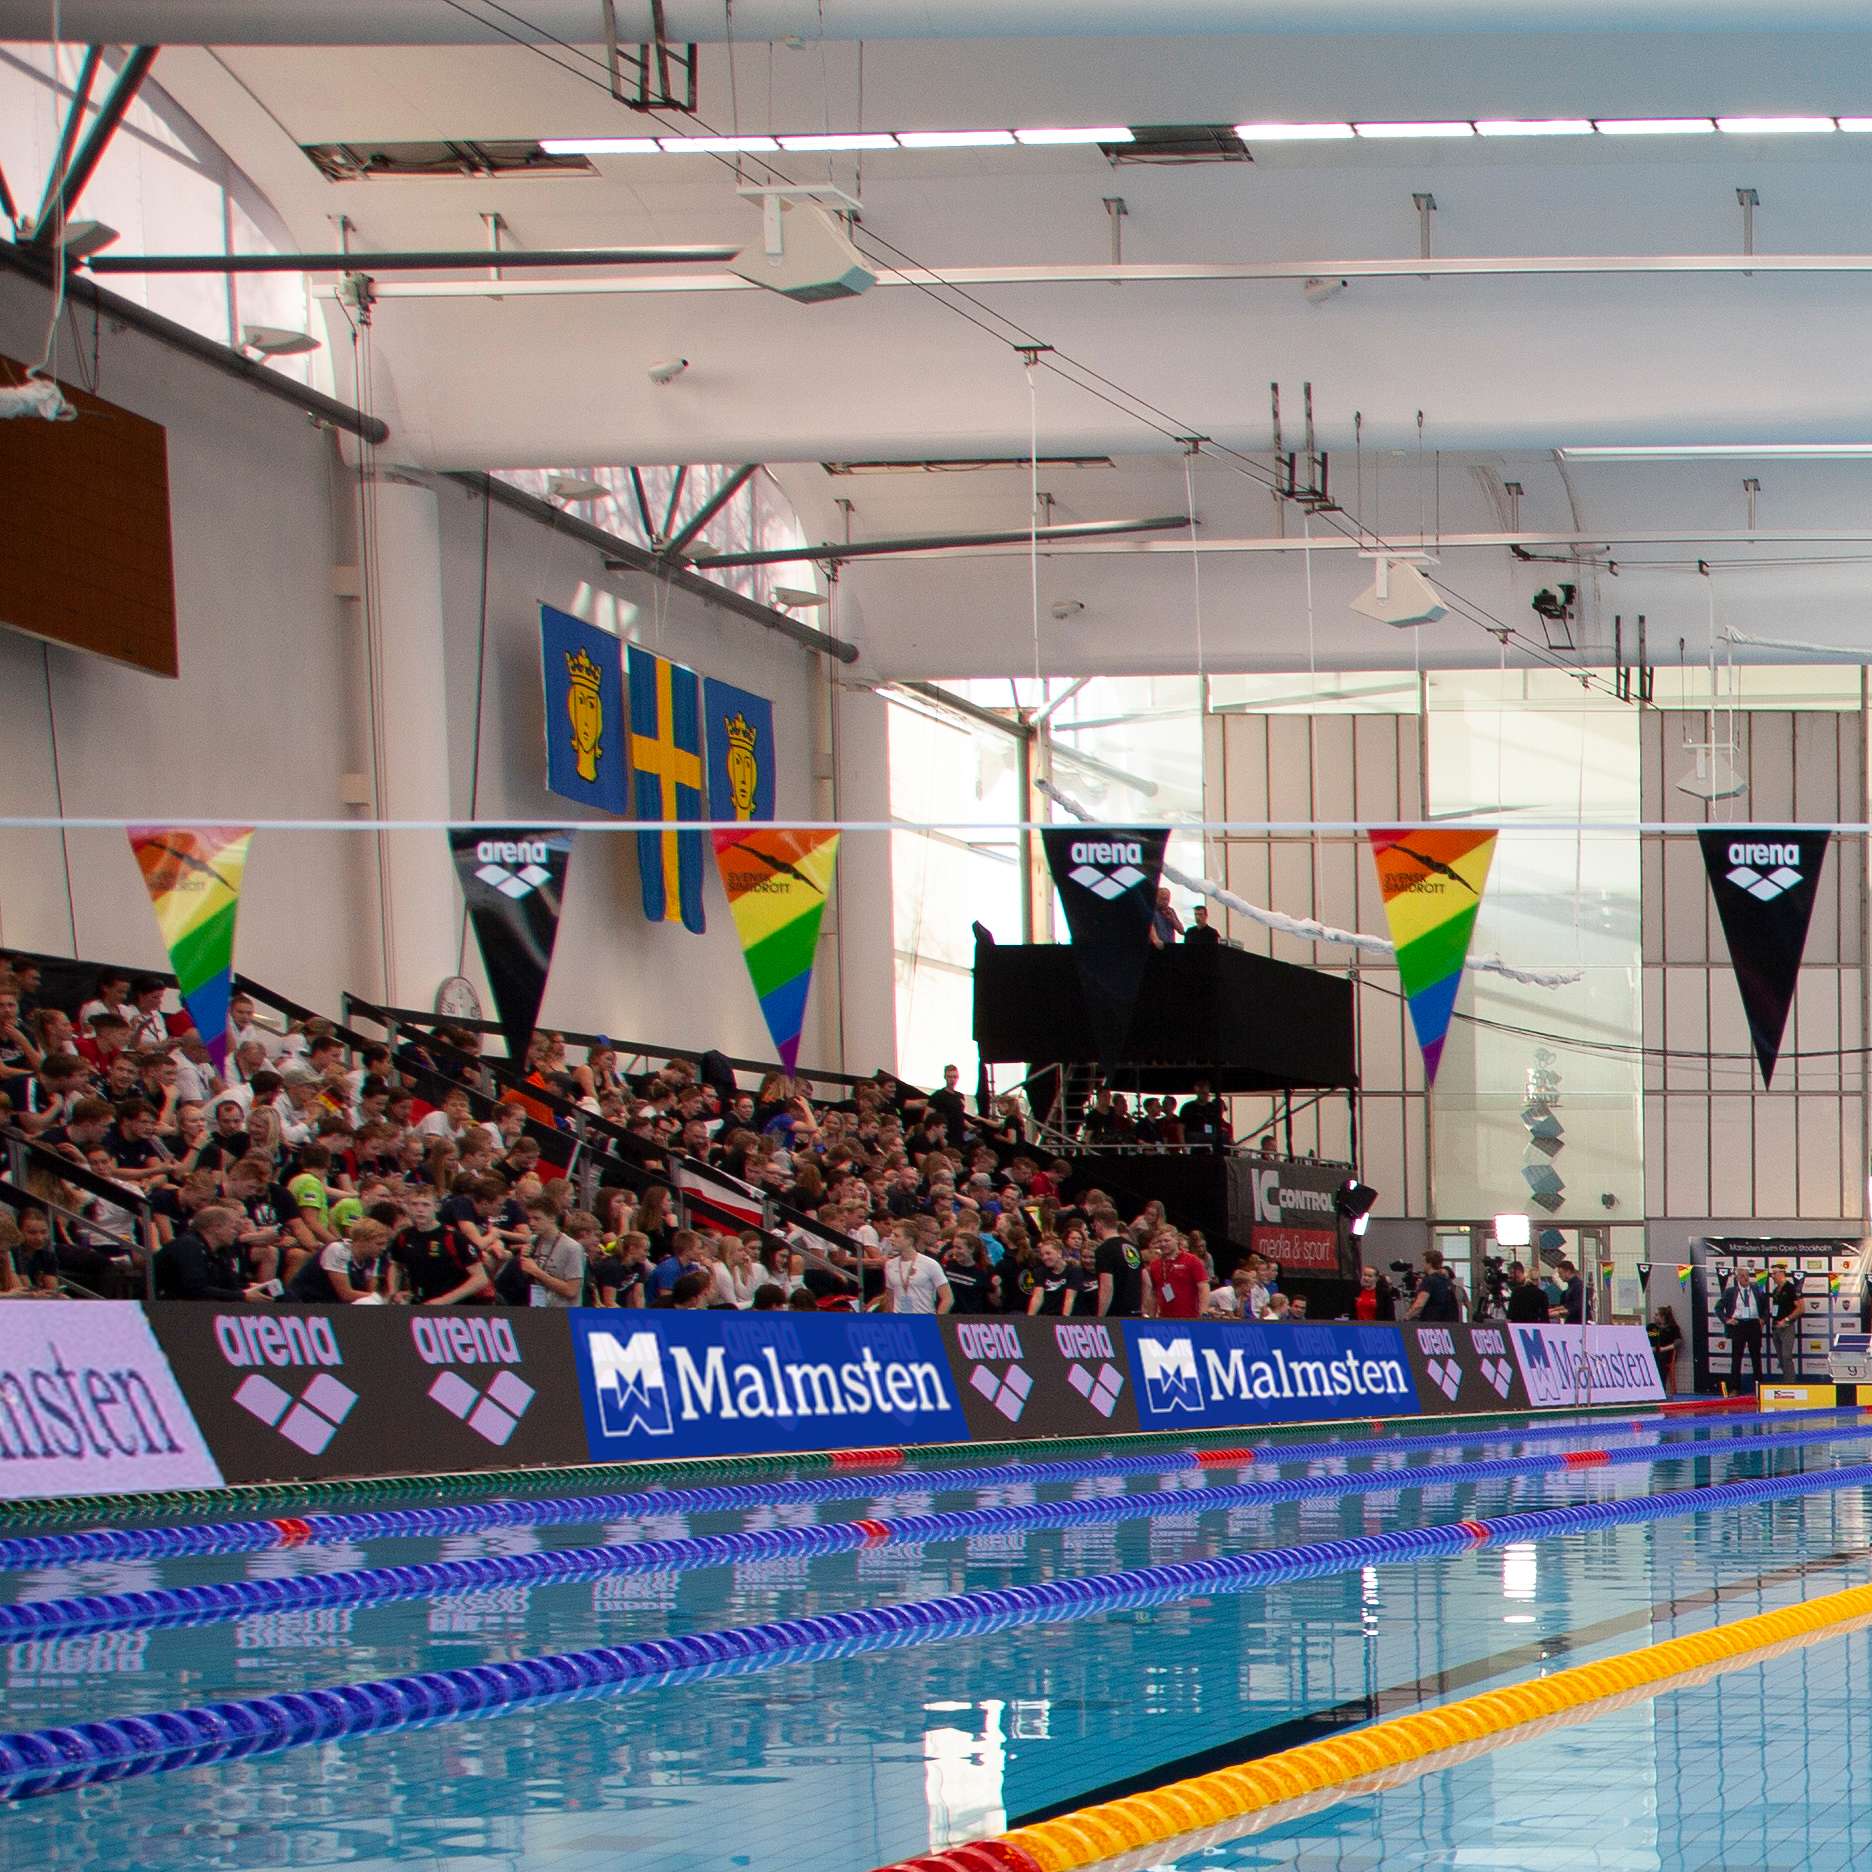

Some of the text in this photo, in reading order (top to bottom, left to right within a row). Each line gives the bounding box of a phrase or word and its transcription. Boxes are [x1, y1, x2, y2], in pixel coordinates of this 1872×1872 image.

[477, 841, 548, 864] arena
[1071, 842, 1143, 865] arena
[1728, 843, 1800, 865] arena
[1251, 1168, 1337, 1223] IC CONTROL
[1259, 1233, 1291, 1260] media
[1304, 1239, 1331, 1264] sport
[215, 1314, 344, 1367] arena
[411, 1315, 521, 1364] arena
[957, 1323, 1023, 1360] arena
[1055, 1324, 1115, 1359] arena
[1416, 1328, 1456, 1355] arena
[1470, 1328, 1506, 1355] arena
[669, 1346, 952, 1421] Malmsten
[1201, 1348, 1408, 1401] Malmsten
